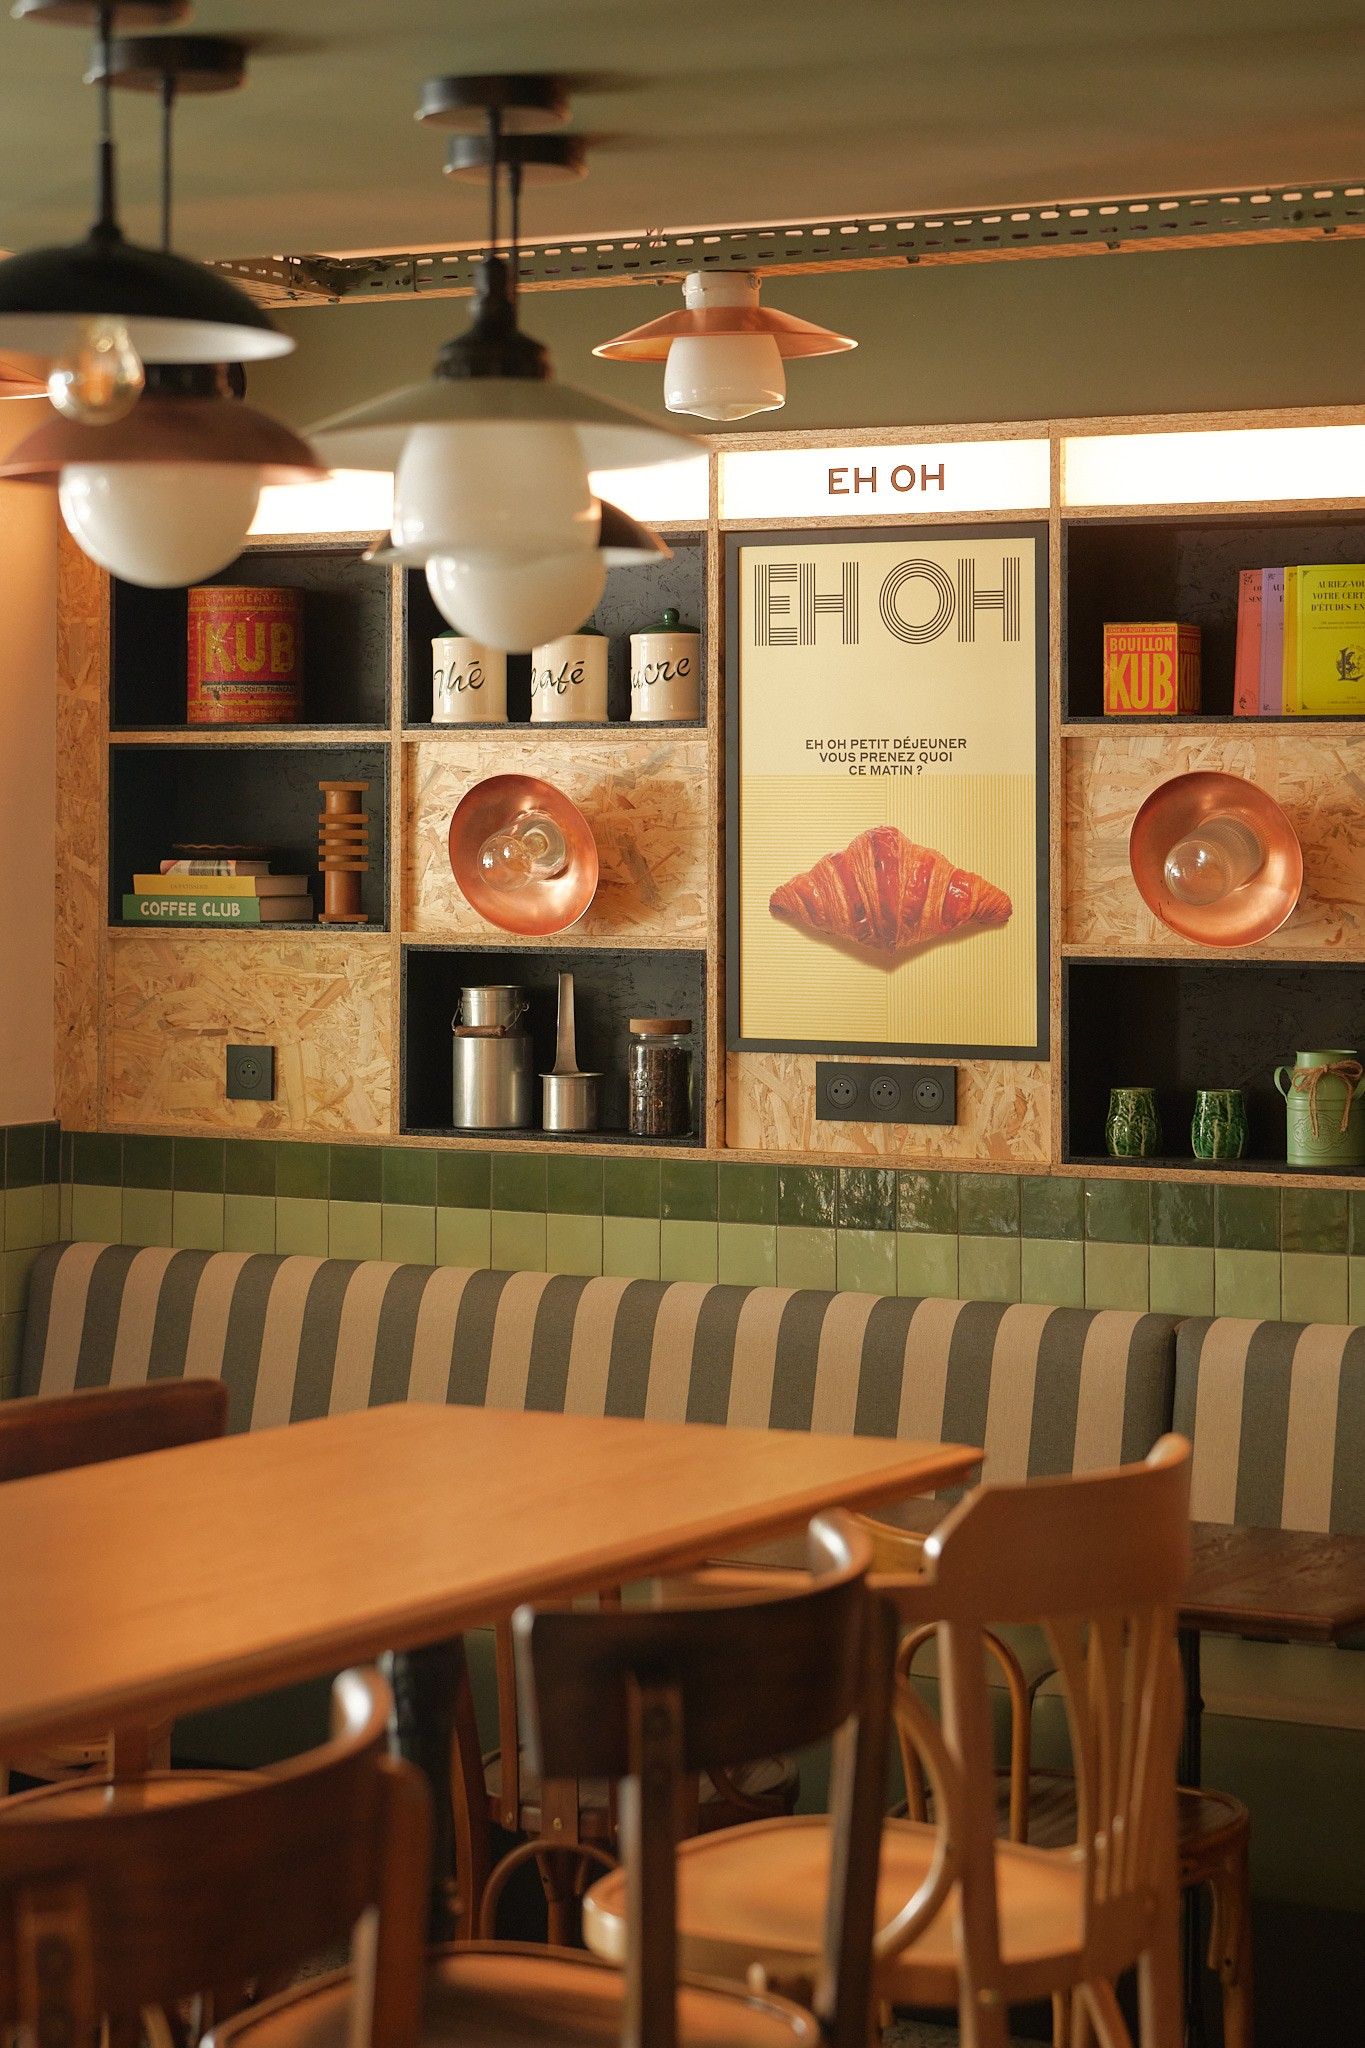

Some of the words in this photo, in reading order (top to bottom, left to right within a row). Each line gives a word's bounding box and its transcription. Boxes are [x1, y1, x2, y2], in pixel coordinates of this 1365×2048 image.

[829, 466, 877, 495] EH
[890, 463, 945, 493] OH
[754, 561, 859, 647] EH
[878, 557, 1021, 645] OH
[205, 621, 296, 674] KUB
[1110, 637, 1173, 652] BOUILLON
[631, 657, 691, 690] ucre
[1109, 653, 1174, 710] KUB
[805, 739, 824, 750] EH
[827, 739, 847, 750] OH
[850, 739, 890, 749] PETIT
[893, 736, 967, 749] DÉJEUNER
[819, 752, 856, 763] VOUS
[860, 752, 916, 762] PRENEZ
[919, 751, 953, 764] QUOI
[849, 765, 867, 776] CE
[870, 765, 913, 776] MATIN
[916, 765, 923, 776] ?
[140, 901, 197, 916] COFFEE
[202, 902, 241, 917] CLUB
